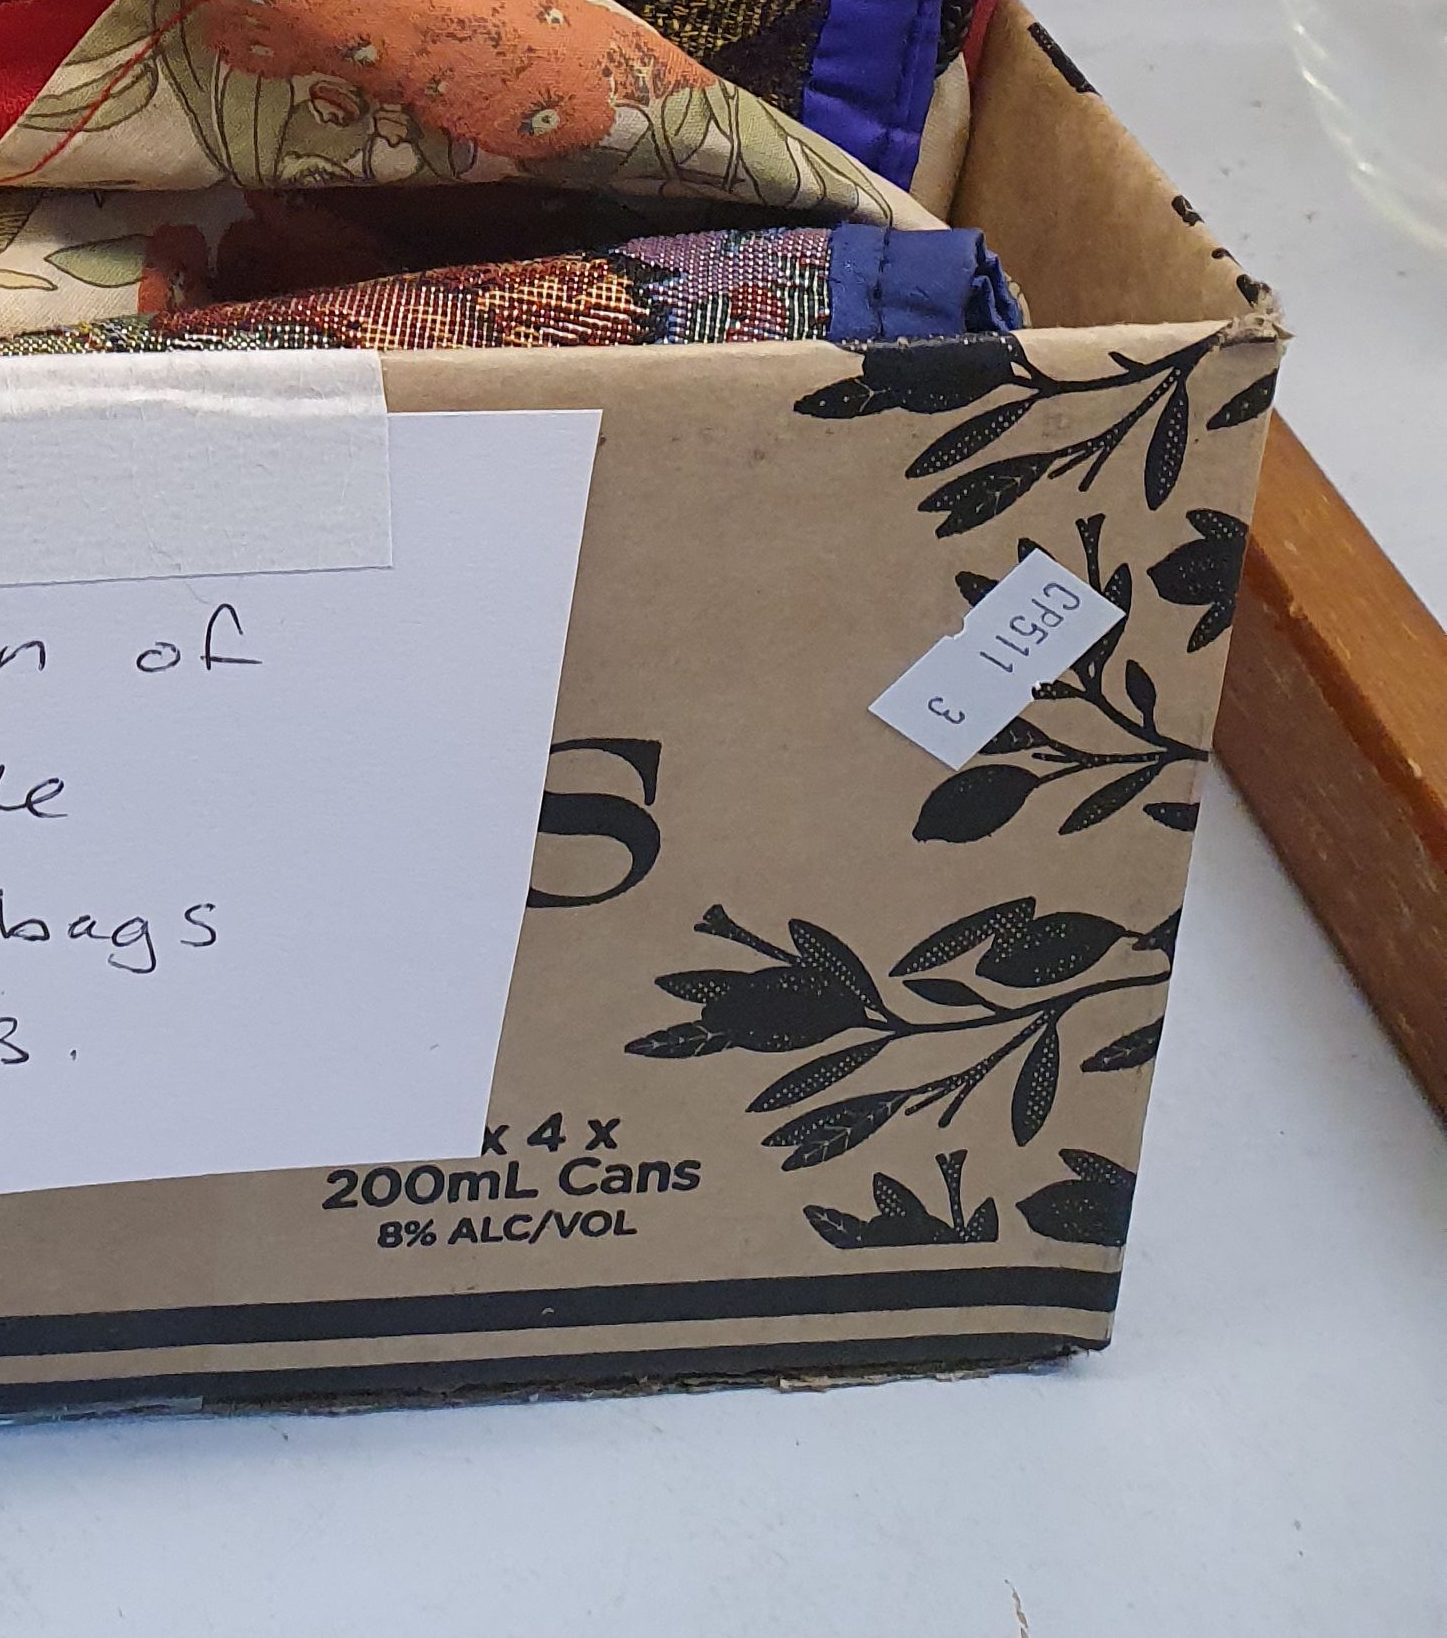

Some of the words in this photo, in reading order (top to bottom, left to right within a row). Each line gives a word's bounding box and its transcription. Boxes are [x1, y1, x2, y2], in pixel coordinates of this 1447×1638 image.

[135, 602, 263, 675] of
[979, 581, 1082, 674] CP511
[927, 696, 967, 725] 3
[526, 1111, 567, 1153] 4
[320, 1160, 540, 1211] 200mL
[558, 1155, 703, 1197] Cans
[376, 1218, 438, 1249] 8%
[447, 1208, 639, 1246] ALC/VOL
